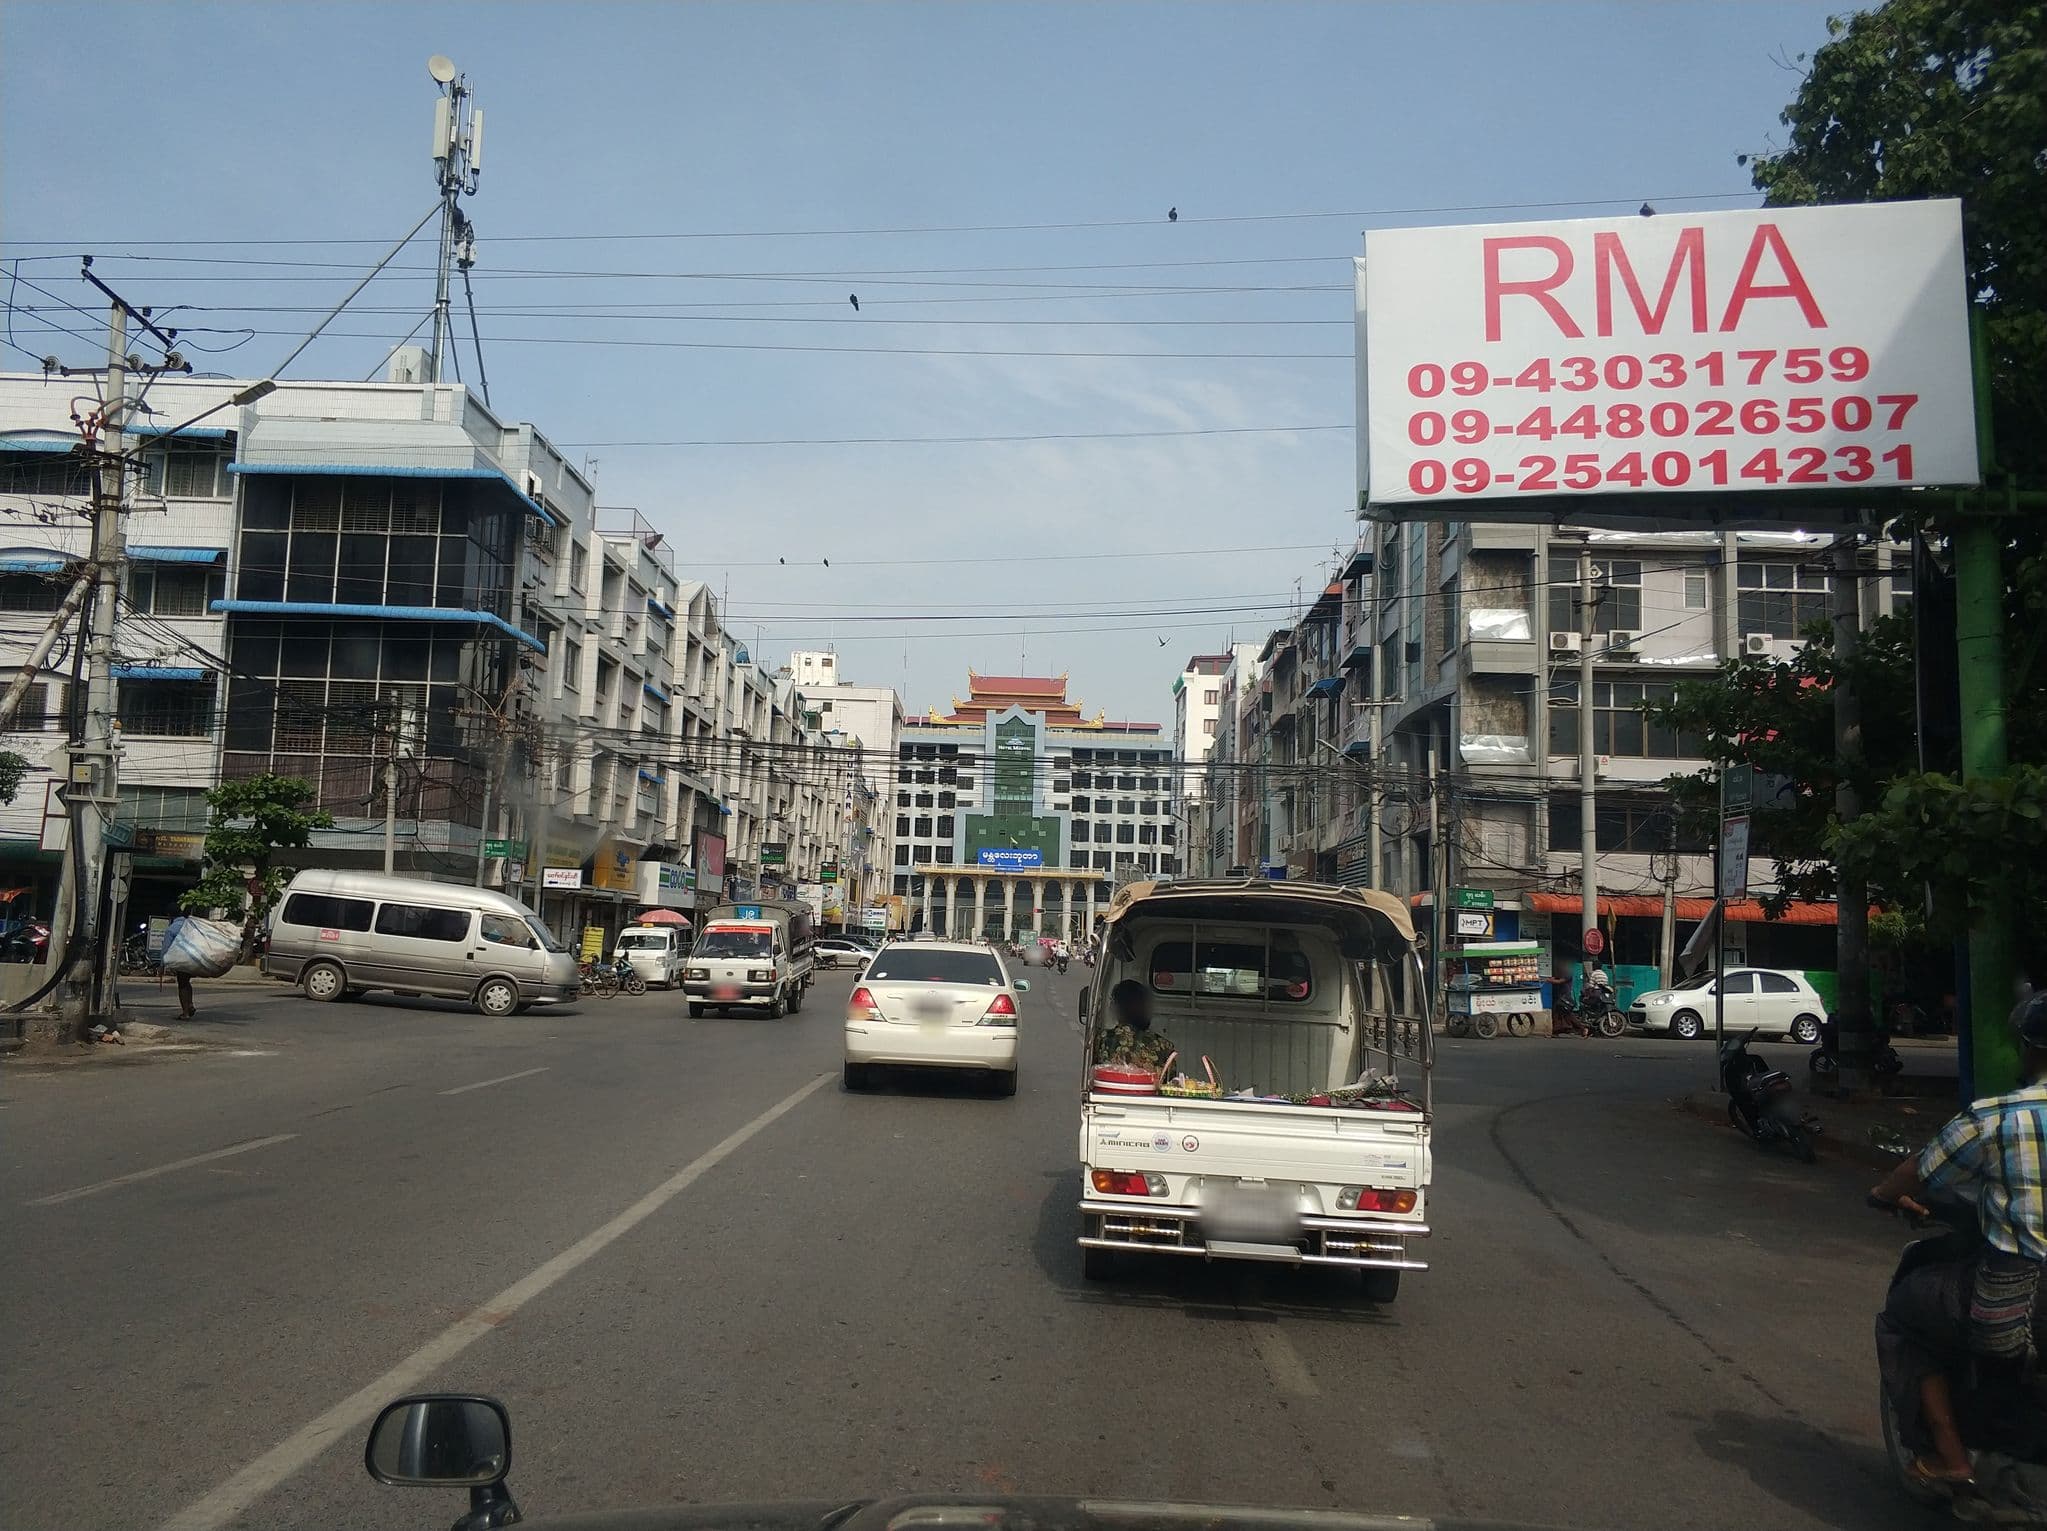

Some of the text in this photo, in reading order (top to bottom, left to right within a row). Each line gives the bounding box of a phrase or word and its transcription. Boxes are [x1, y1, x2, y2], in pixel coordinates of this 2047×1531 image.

[1483, 224, 1827, 341] RMA
[1406, 347, 1870, 398] 09-43031759
[1407, 395, 1917, 446] 09-448026507
[1407, 444, 1912, 495] 09-254014231
